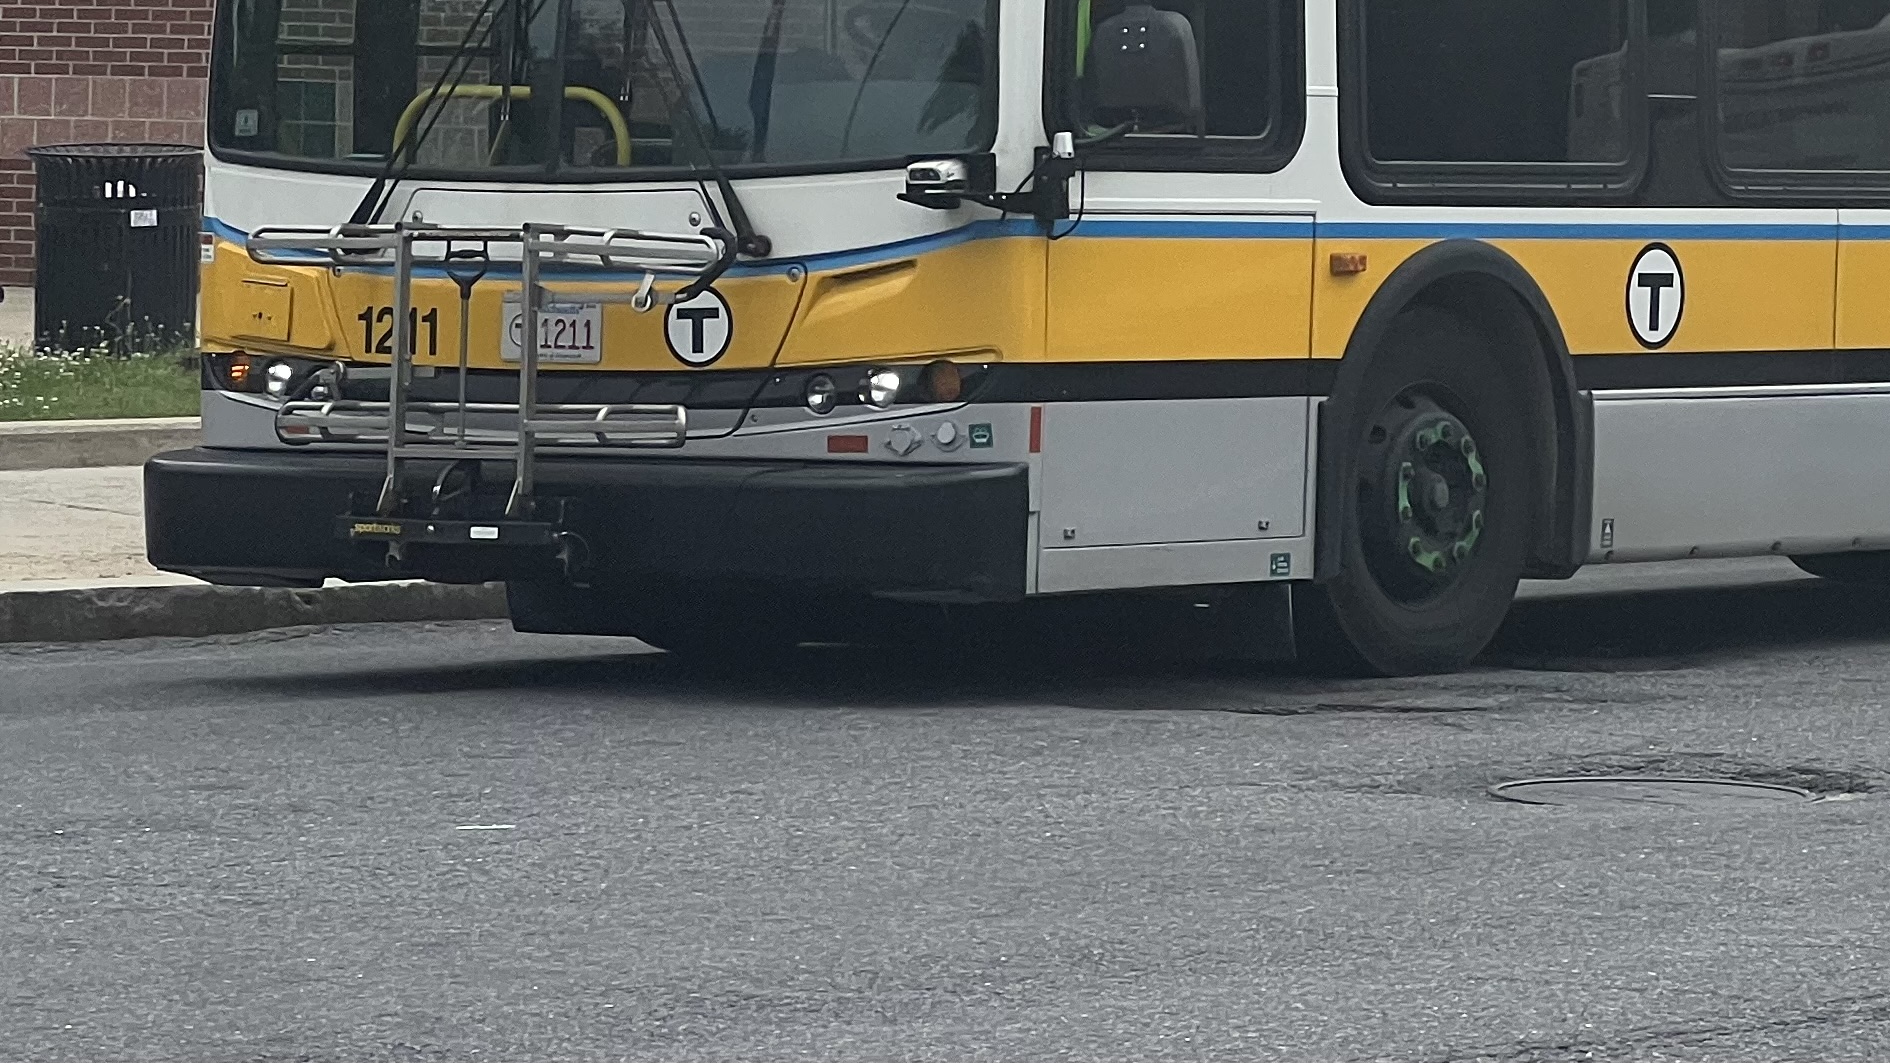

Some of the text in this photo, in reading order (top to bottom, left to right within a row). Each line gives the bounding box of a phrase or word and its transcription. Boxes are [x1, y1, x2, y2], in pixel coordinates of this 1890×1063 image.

[1637, 272, 1674, 332] T
[357, 305, 438, 356] 1211
[540, 317, 595, 350] 1211
[676, 307, 720, 354] T
